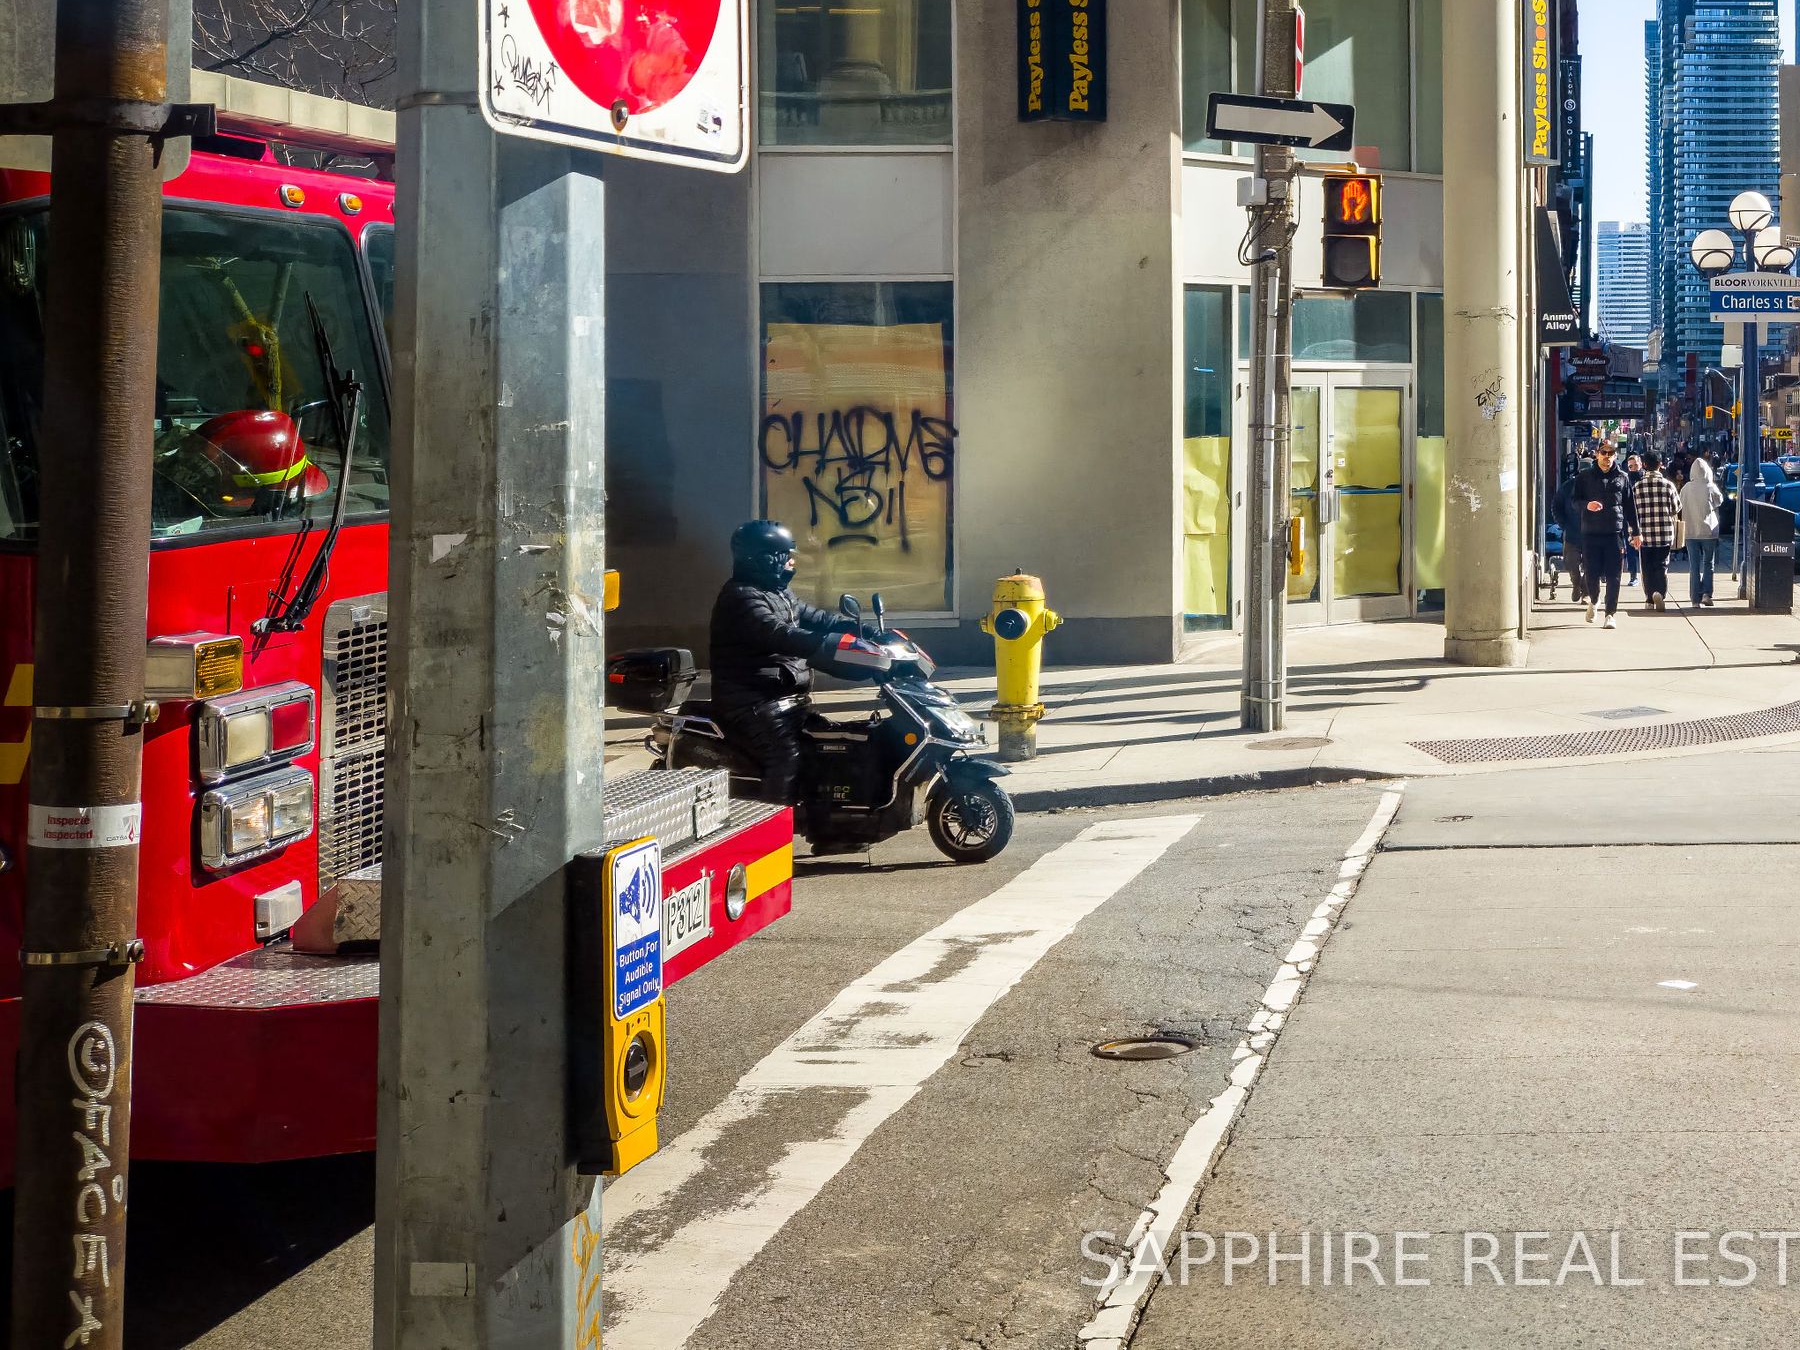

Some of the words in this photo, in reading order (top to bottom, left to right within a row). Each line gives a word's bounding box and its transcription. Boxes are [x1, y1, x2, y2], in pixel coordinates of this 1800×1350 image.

[1028, 11, 1044, 112] Payless
[1069, 11, 1093, 112] Payless
[1532, 72, 1550, 157] Payless
[1722, 294, 1771, 309] Charles
[1773, 296, 1783, 308] St
[1542, 313, 1574, 321] Anime
[1545, 322, 1571, 331] Alley
[1770, 544, 1788, 553] Litter
[619, 946, 645, 967] Button
[645, 940, 658, 957] For
[625, 962, 653, 985] Audible
[619, 984, 641, 1006] Signal
